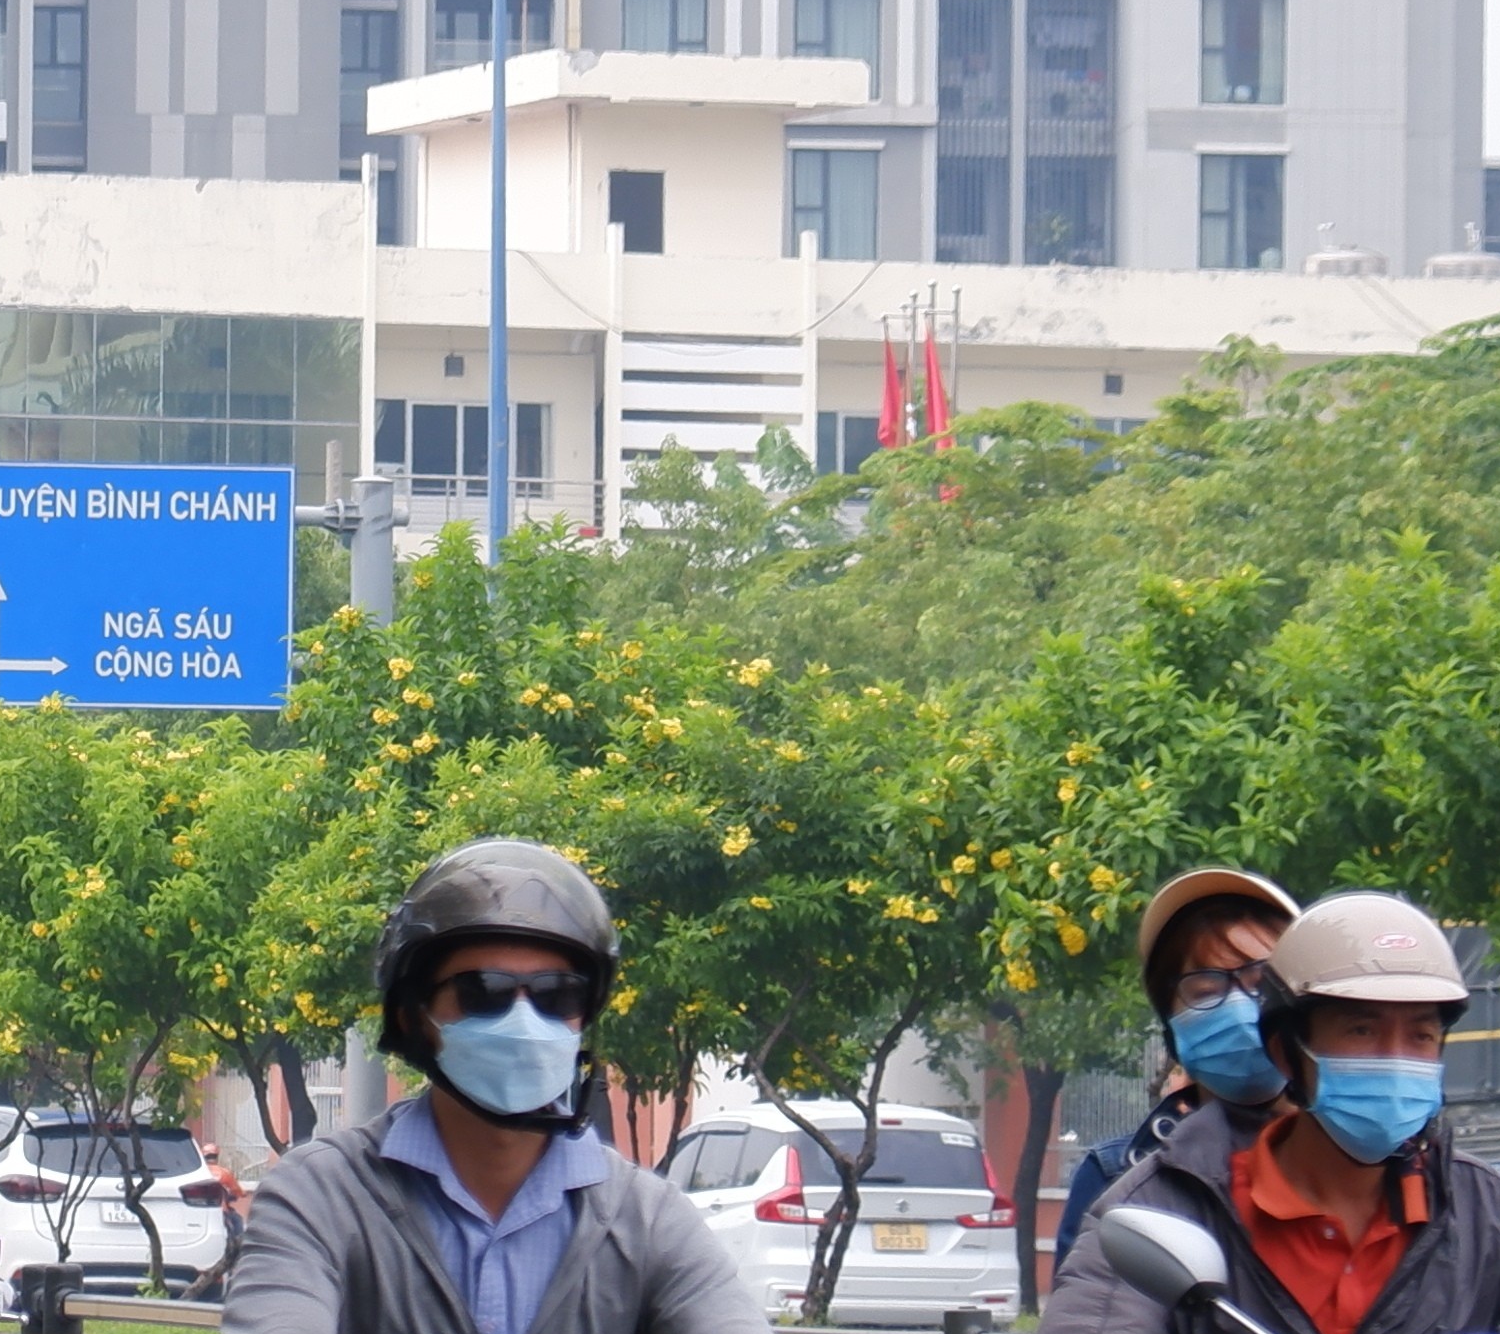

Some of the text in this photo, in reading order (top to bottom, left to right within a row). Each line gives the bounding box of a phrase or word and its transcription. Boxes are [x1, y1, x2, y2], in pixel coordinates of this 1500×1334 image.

[86, 482, 161, 520] BÌNH
[169, 484, 277, 522] CHÁNH
[104, 606, 232, 640] NGÃ SÁU
[94, 644, 242, 682] CỘNG HÒA
